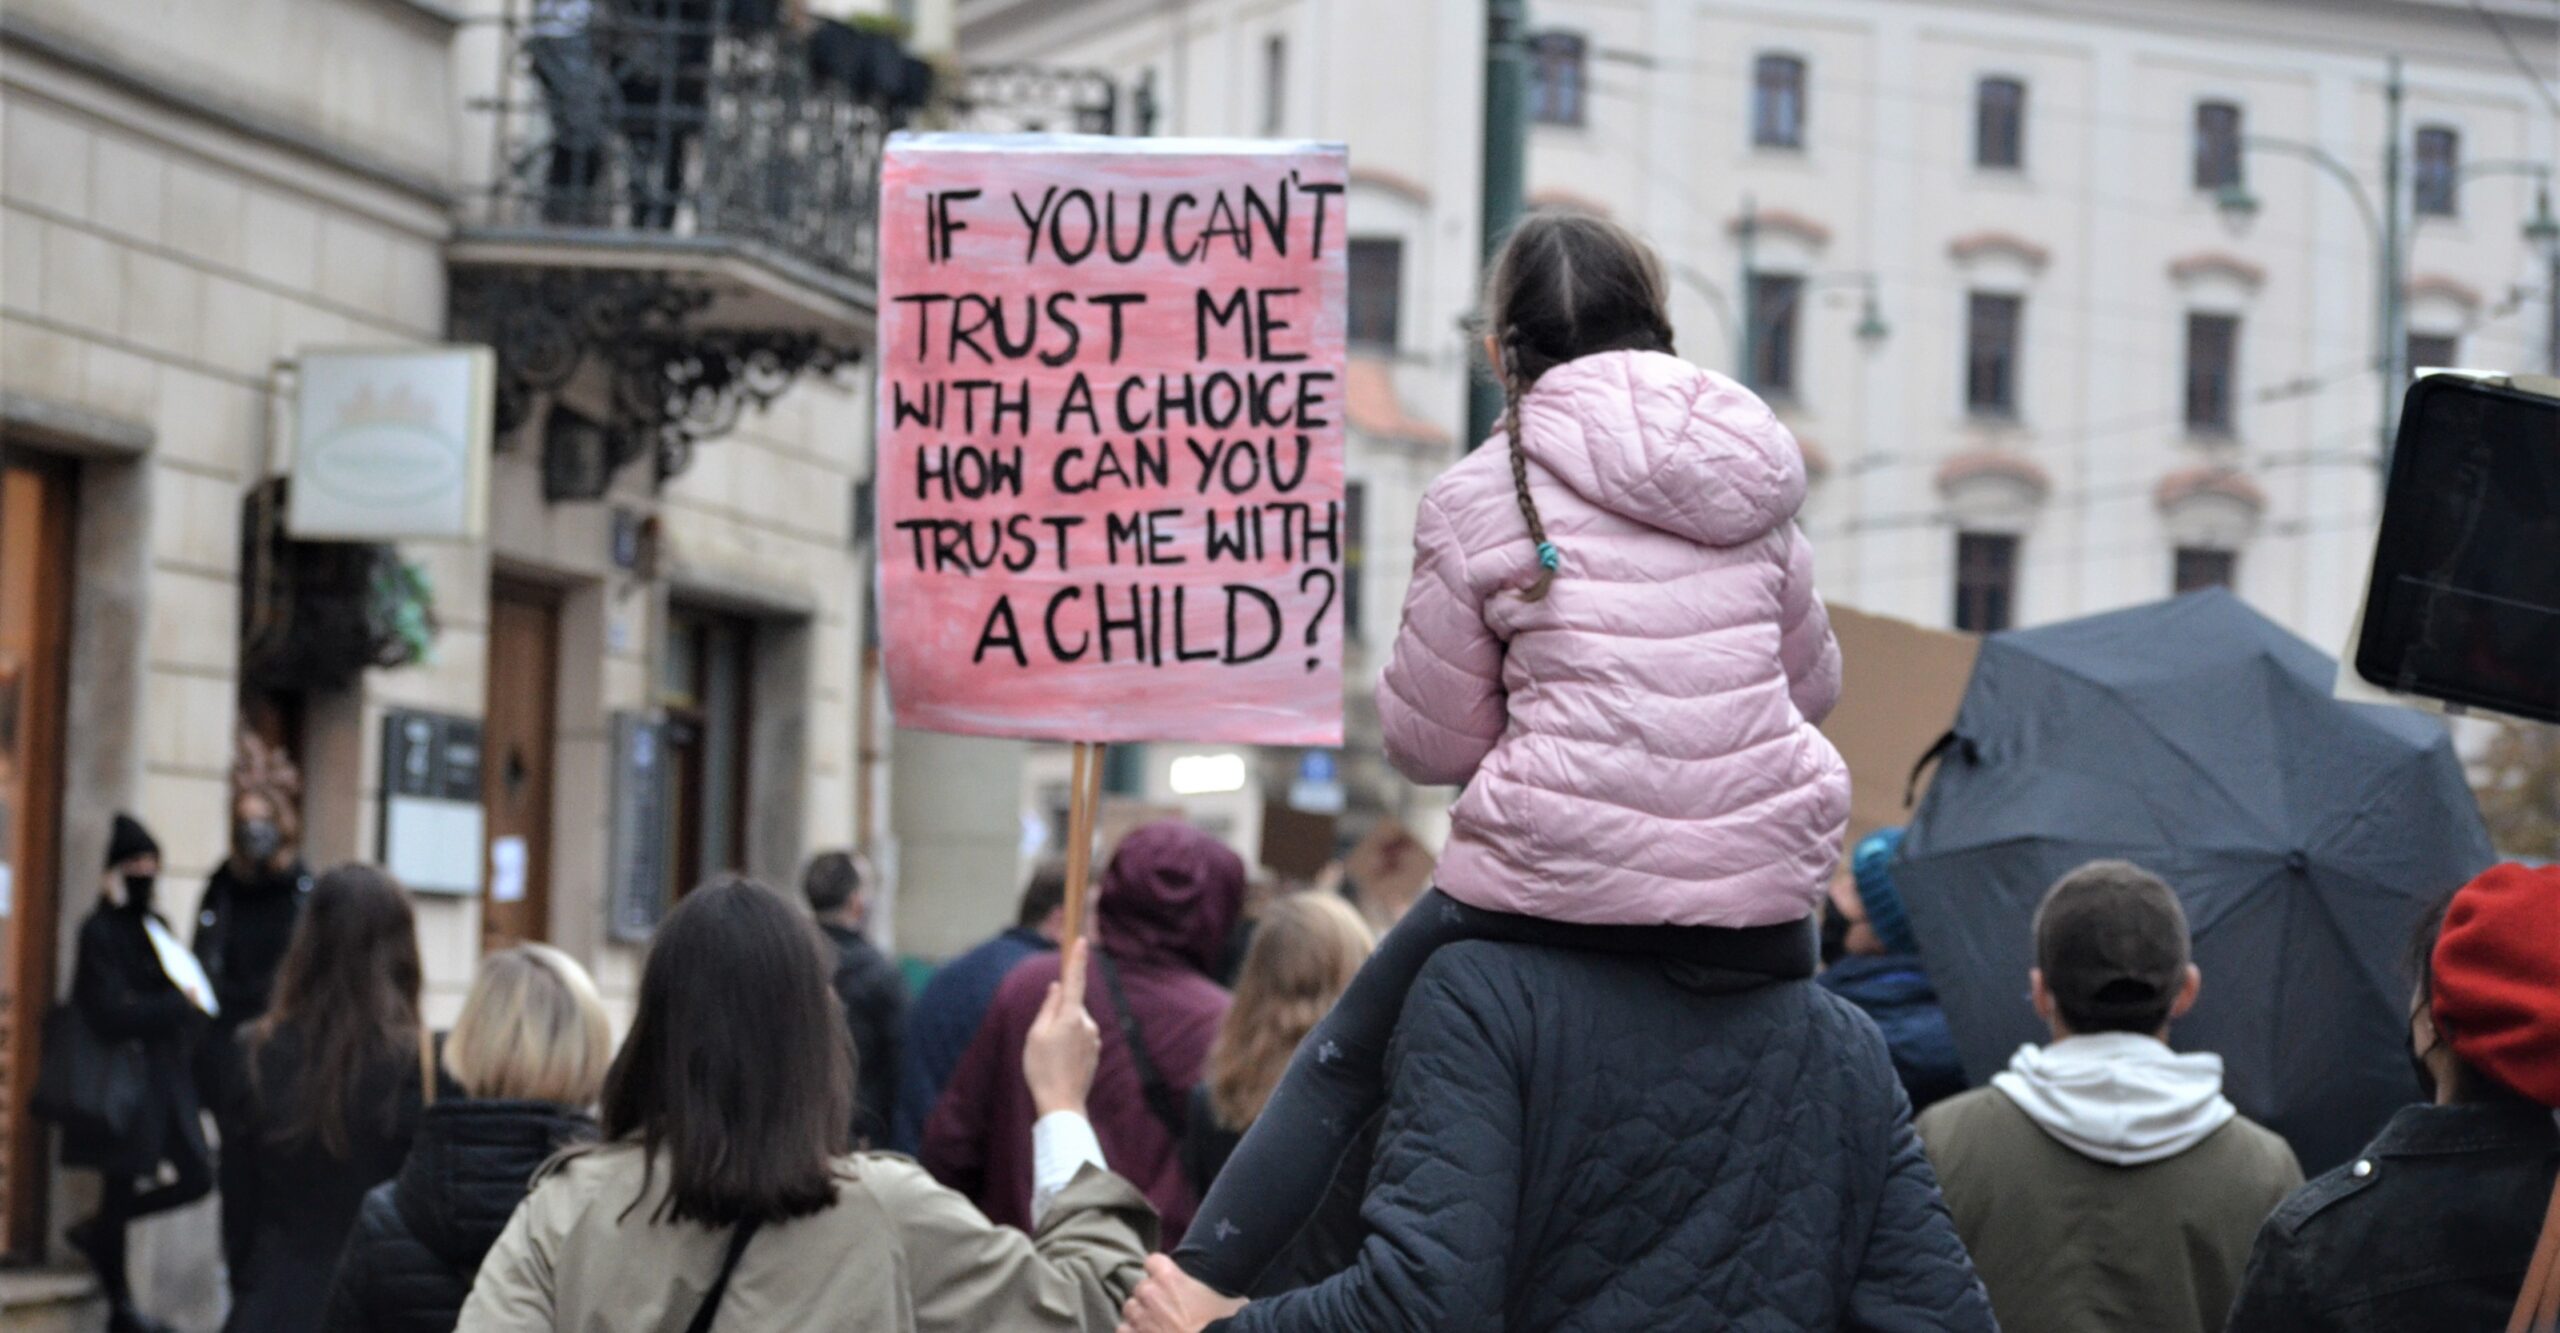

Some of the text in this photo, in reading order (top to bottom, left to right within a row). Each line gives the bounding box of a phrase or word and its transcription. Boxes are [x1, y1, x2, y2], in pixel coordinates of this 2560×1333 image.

[927, 169, 1345, 265] IF YOU CAN'T
[893, 287, 1310, 367] TRUST ME
[894, 372, 1335, 435] WITH A CHOICE
[917, 435, 1311, 501] HOW CAN YOU
[895, 501, 1339, 576] TRUST ME WITH
[972, 594, 1028, 668] A
